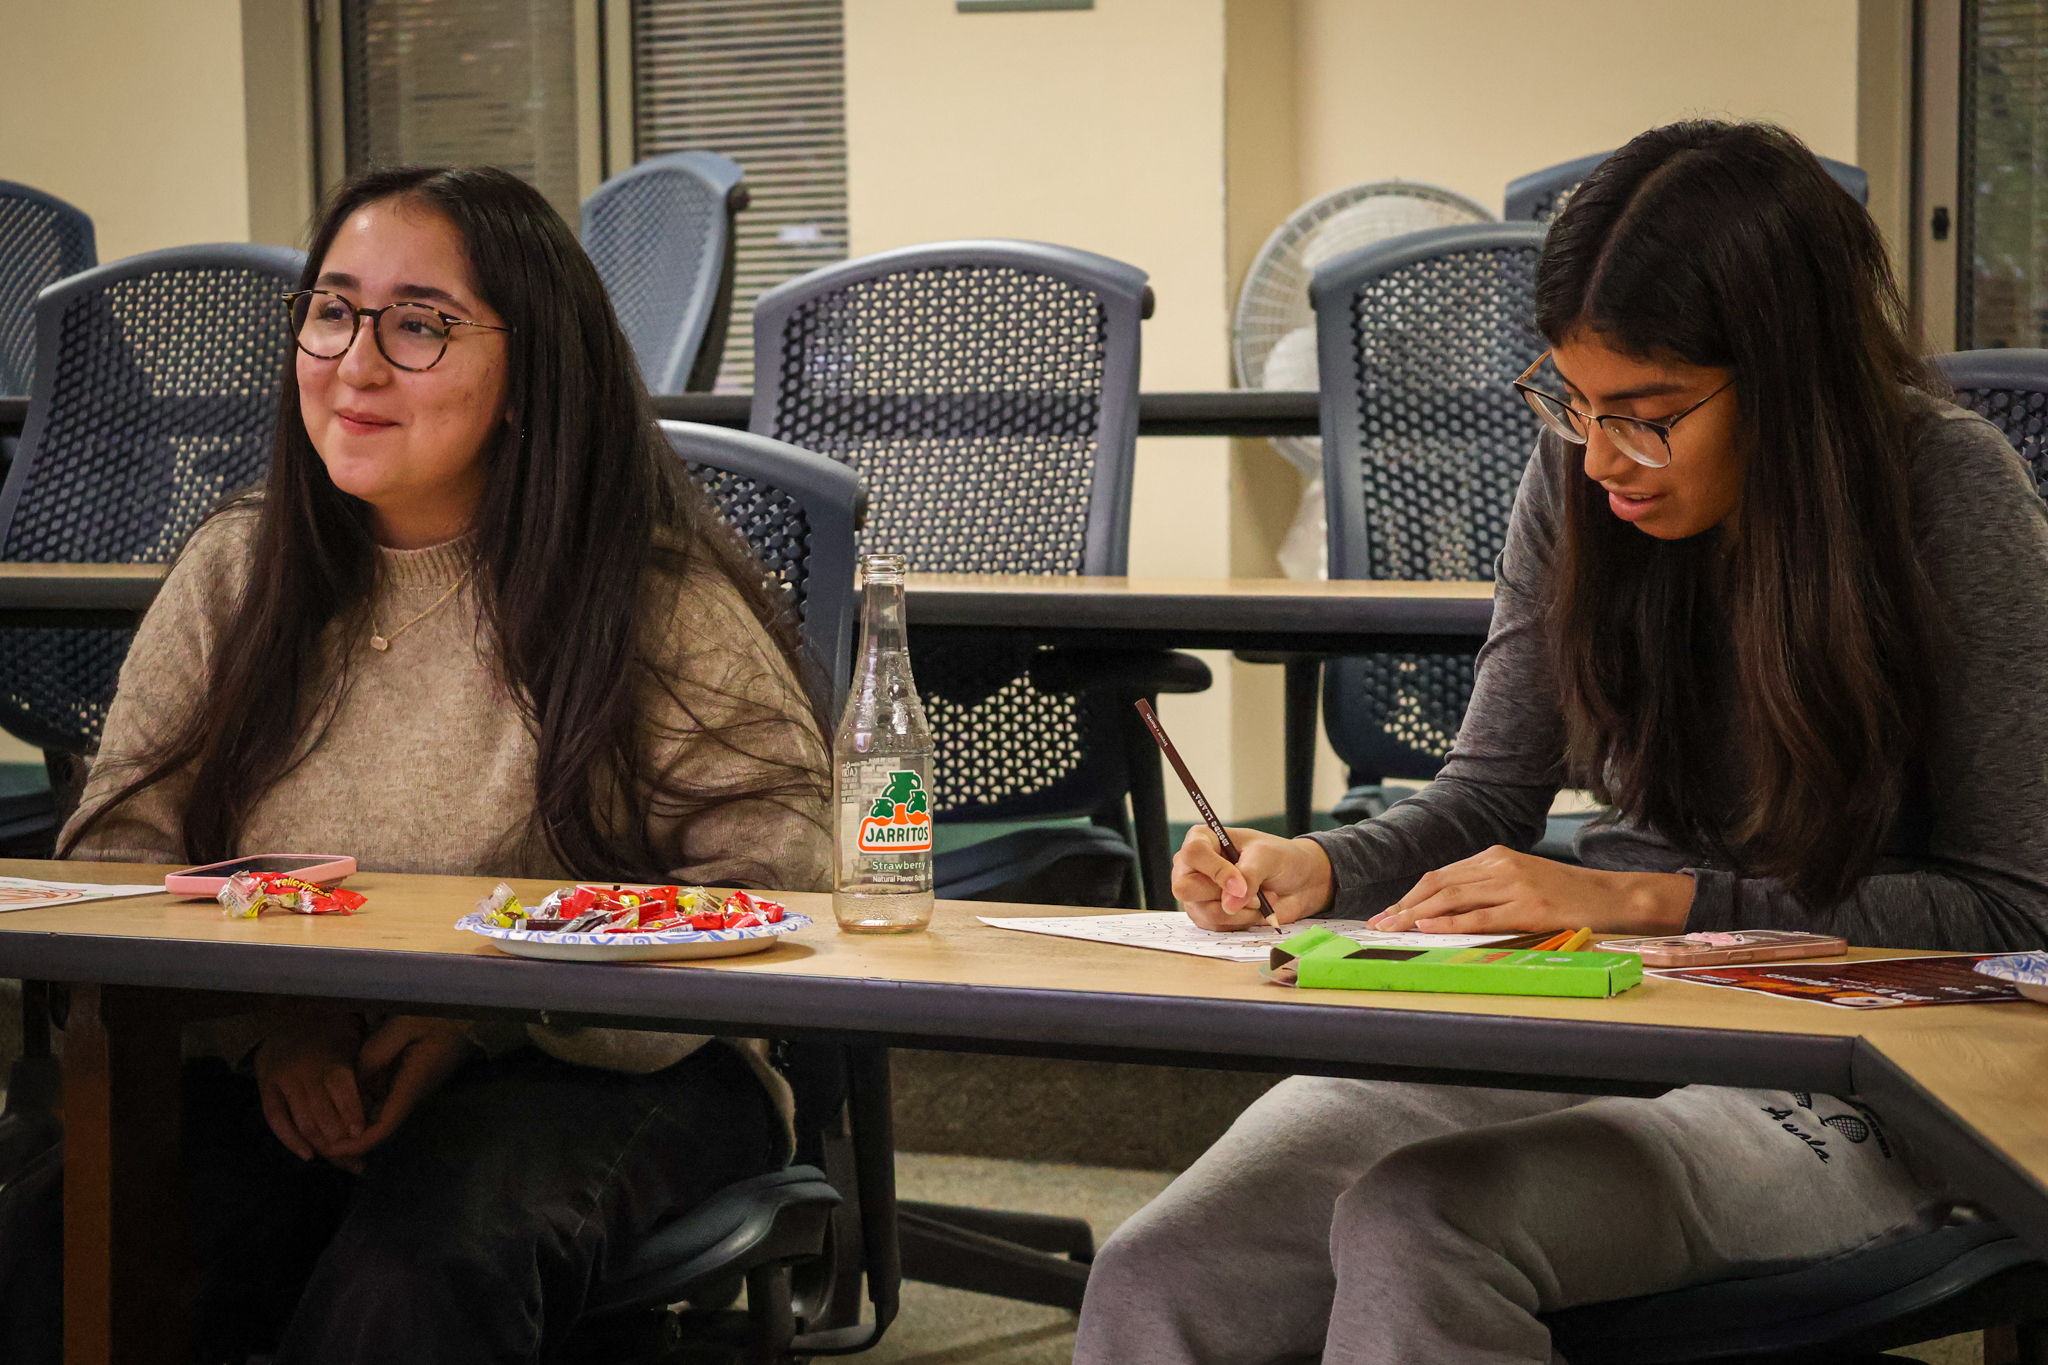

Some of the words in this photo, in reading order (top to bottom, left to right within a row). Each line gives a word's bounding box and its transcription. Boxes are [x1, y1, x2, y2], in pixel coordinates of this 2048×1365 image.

[865, 826, 929, 843] JARRITOS
[872, 860, 926, 871] Strawberry
[872, 875, 896, 883] Natural
